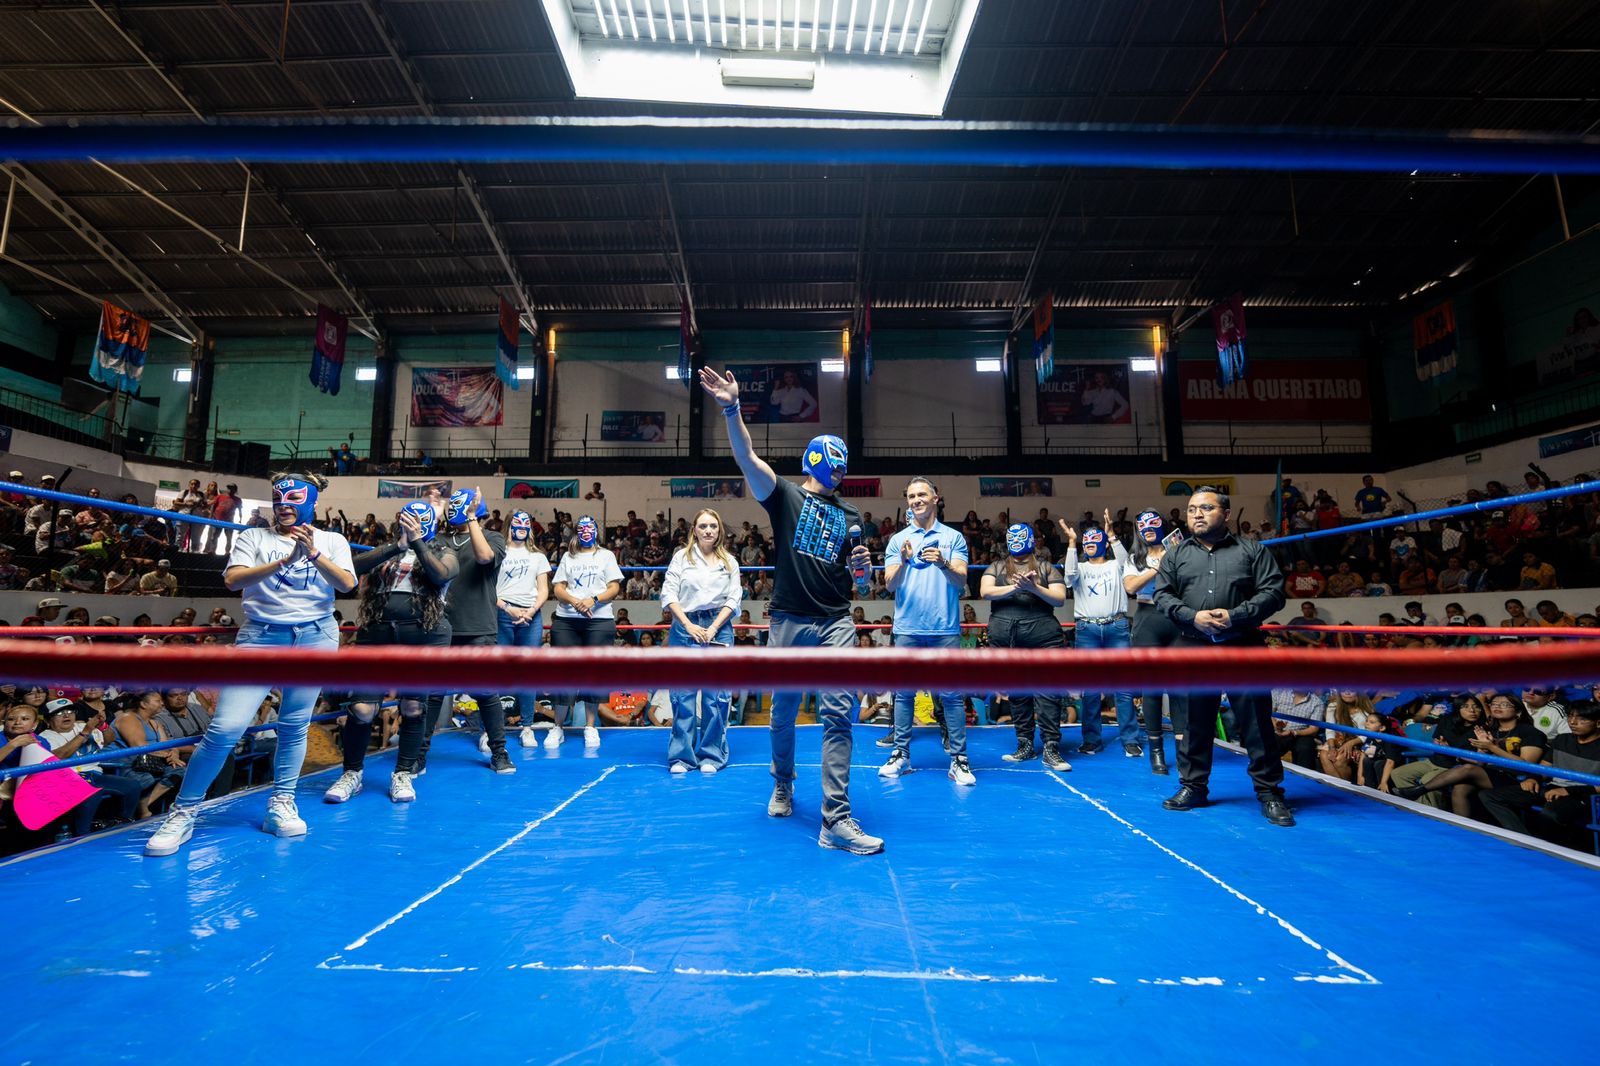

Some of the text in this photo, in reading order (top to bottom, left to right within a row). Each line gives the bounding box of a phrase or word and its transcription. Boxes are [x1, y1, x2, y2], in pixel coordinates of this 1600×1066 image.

[415, 384, 452, 396] DULCE
[1040, 382, 1076, 393] DULCE
[1253, 378, 1362, 402] QUERETARO
